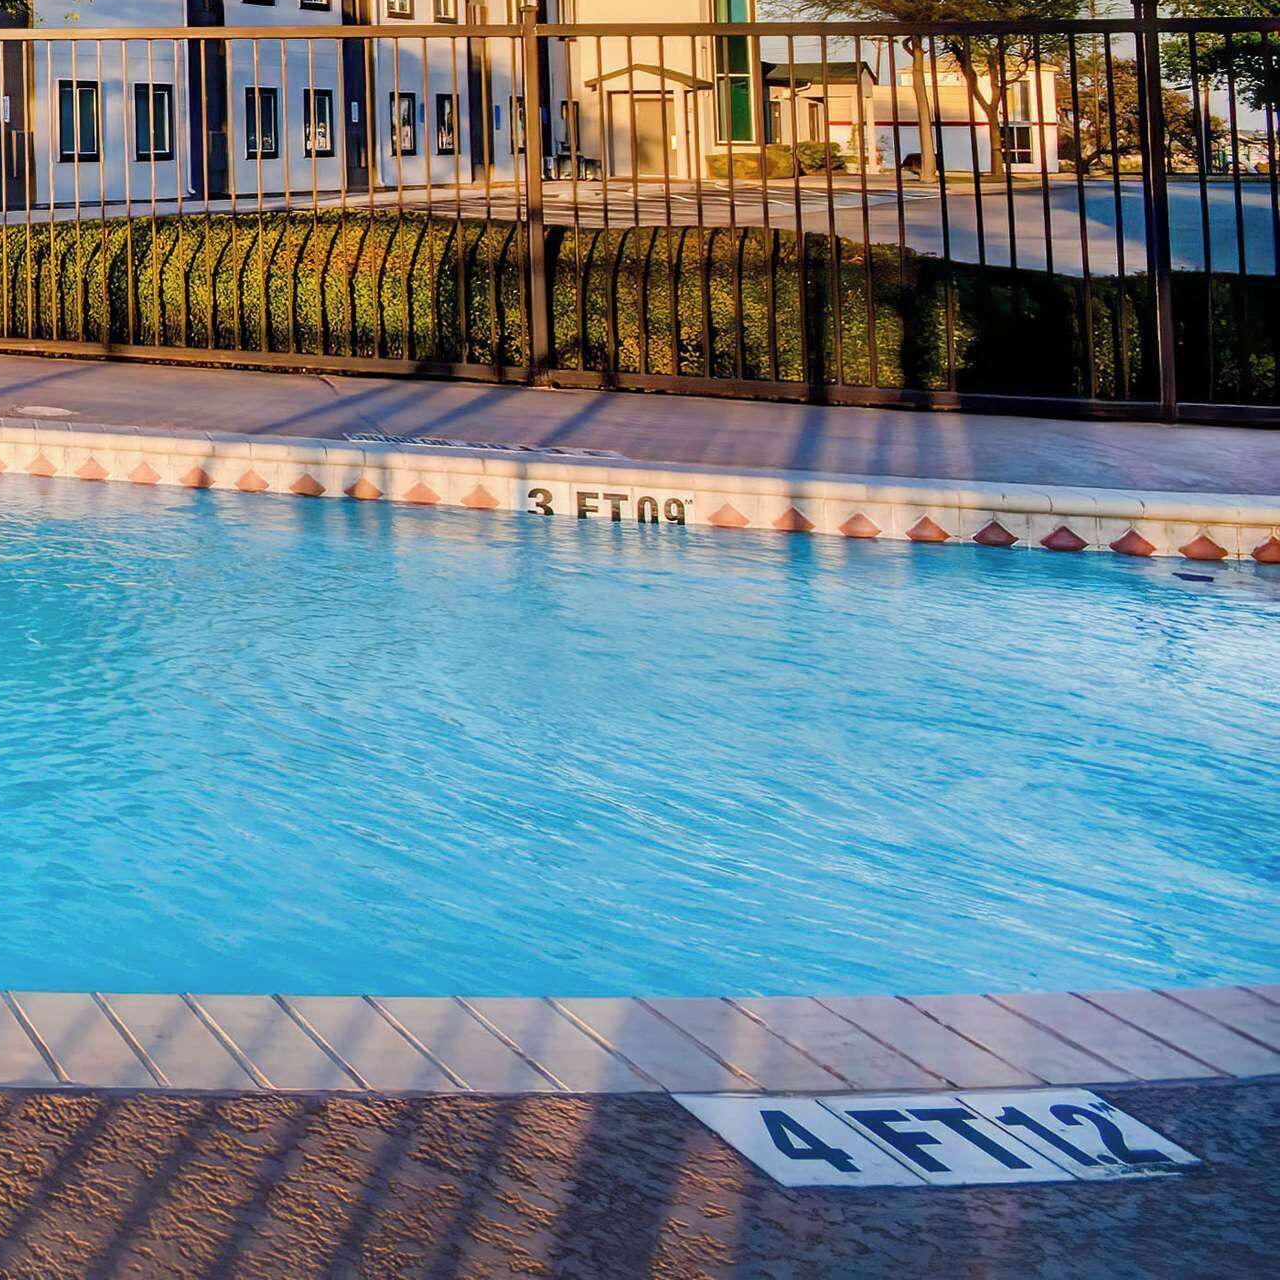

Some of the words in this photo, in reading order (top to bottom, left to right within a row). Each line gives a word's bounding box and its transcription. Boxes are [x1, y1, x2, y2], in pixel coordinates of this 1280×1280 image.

[527, 488, 554, 516] 3
[576, 491, 629, 522] FT
[759, 1109, 863, 1173] 4
[844, 1107, 1034, 1172] FT
